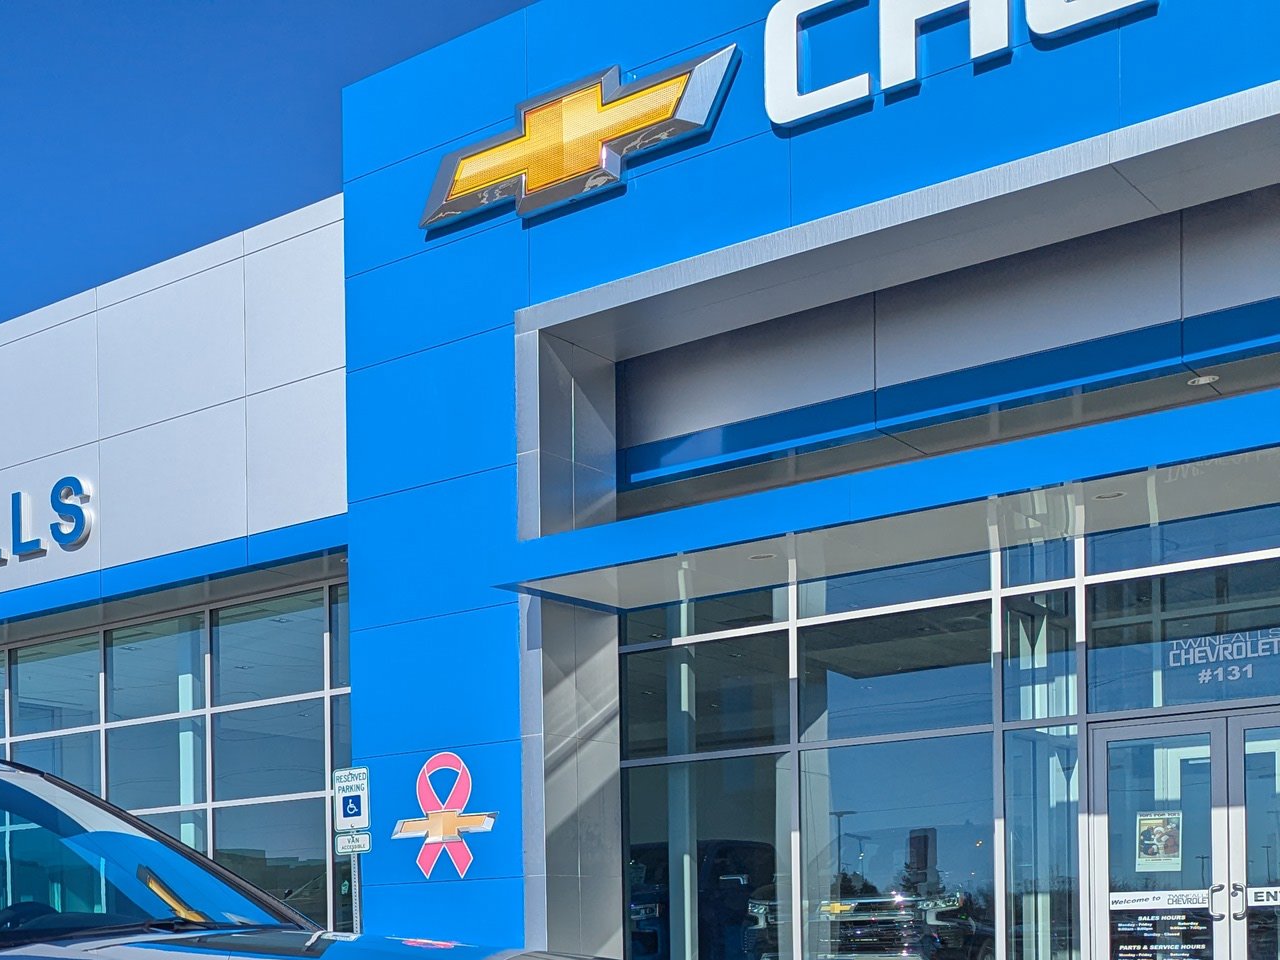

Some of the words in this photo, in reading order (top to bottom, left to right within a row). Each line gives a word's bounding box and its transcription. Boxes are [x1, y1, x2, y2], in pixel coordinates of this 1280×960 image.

[1169, 638, 1280, 667] CHEVROLET
[1198, 663, 1253, 684] #131
[336, 772, 366, 783] RESERVED
[338, 783, 365, 794] PARKING
[1111, 897, 1151, 906] Welcome
[1167, 897, 1208, 905] CHEVROLE
[1254, 891, 1280, 902] EN
